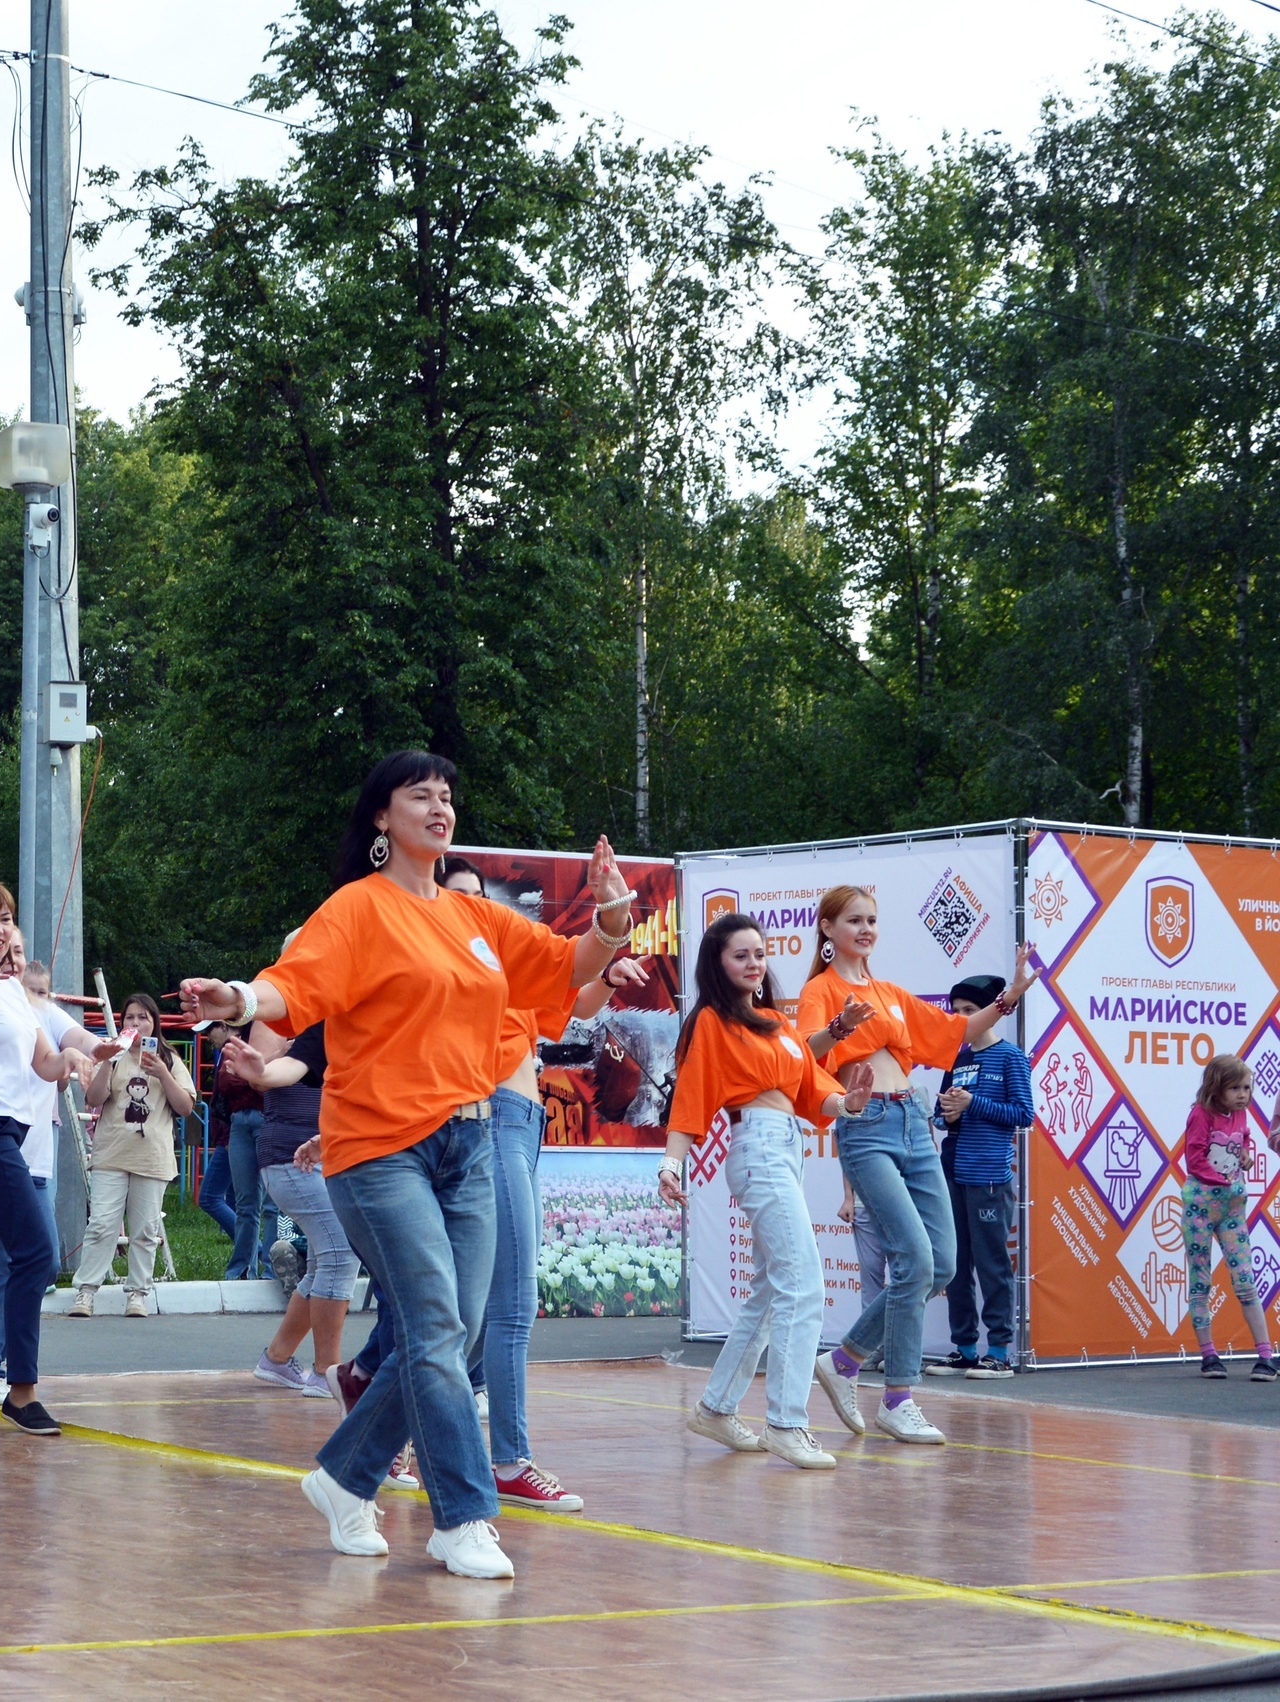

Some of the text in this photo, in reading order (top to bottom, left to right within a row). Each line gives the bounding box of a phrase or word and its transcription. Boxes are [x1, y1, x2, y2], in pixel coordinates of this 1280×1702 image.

[749, 890, 782, 902] ПРОЕКТ
[784, 888, 814, 900] ГЛАВЫ
[917, 866, 953, 919] MINCULT12.RU
[953, 874, 983, 914] АФИША
[749, 903, 818, 930] МАРИЙ
[1255, 918, 1263, 931] В
[765, 934, 802, 957] ЕТО
[953, 912, 991, 968] МЕРОПРИЯТИЙ
[1101, 976, 1236, 992] ПРОЕКТ ГЛАВЫ РЕСПУБЛИКИ
[1089, 994, 1247, 1026] МАРИЙСКОЕ
[1124, 1030, 1215, 1066] ЛЕТО
[1068, 1186, 1107, 1241] ХУДОЖНИКИ
[1078, 1184, 1108, 1226] УЛИЧНЫЕ
[1050, 1213, 1089, 1268] ПЛОЩАДКИ
[1051, 1196, 1100, 1266] ТАНЦЕВАЛЬНЫЕ
[1107, 1281, 1149, 1339] МЕРОПРИЯТИЯ
[1114, 1275, 1153, 1329] СПОРТИВНЫЕ
